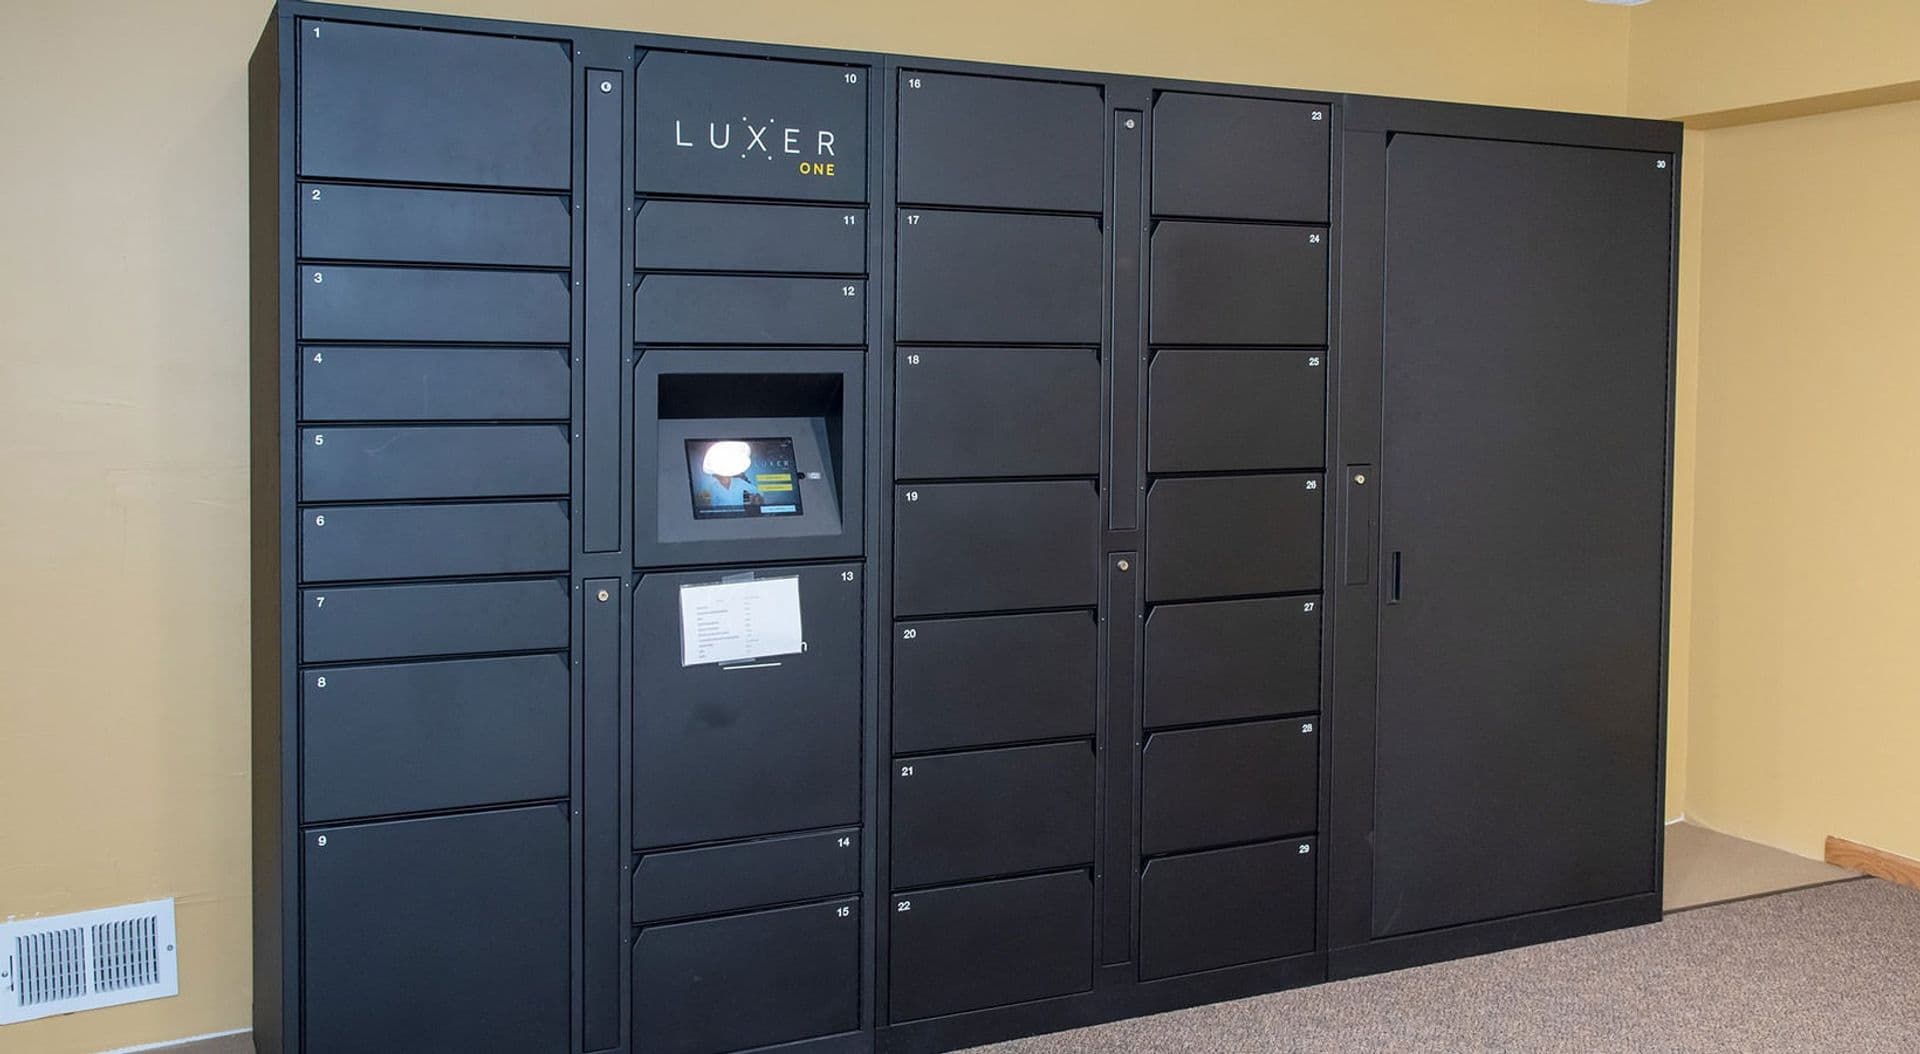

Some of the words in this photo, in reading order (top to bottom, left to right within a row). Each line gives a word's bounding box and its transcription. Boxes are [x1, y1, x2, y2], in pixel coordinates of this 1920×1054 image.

[313, 27, 320, 38] 1
[844, 73, 857, 84] 10
[909, 78, 921, 89] 16
[1311, 111, 1322, 121] 23
[675, 118, 836, 159] LUXER
[798, 162, 836, 176] ONE
[311, 189, 321, 201] 2
[843, 215, 855, 225] 11
[907, 215, 920, 225] 17
[1309, 234, 1320, 244] 24
[313, 272, 323, 284] 3
[842, 285, 855, 296] 12
[313, 352, 323, 364] 4
[907, 354, 920, 365] 18
[1308, 356, 1320, 367] 25
[314, 434, 324, 446] 5
[1305, 479, 1317, 490] 26
[905, 491, 918, 502] 19
[315, 515, 325, 527] 6
[841, 571, 854, 581] 13
[316, 596, 325, 608] 7
[1303, 602, 1315, 612] 27
[903, 628, 917, 640] 20
[317, 676, 327, 688] 8
[1301, 723, 1313, 733] 28
[901, 766, 913, 777] 21
[318, 835, 327, 847] 9
[837, 837, 850, 848] 14
[1298, 844, 1310, 854] 29
[836, 906, 850, 917] 15
[897, 900, 911, 912] 22
